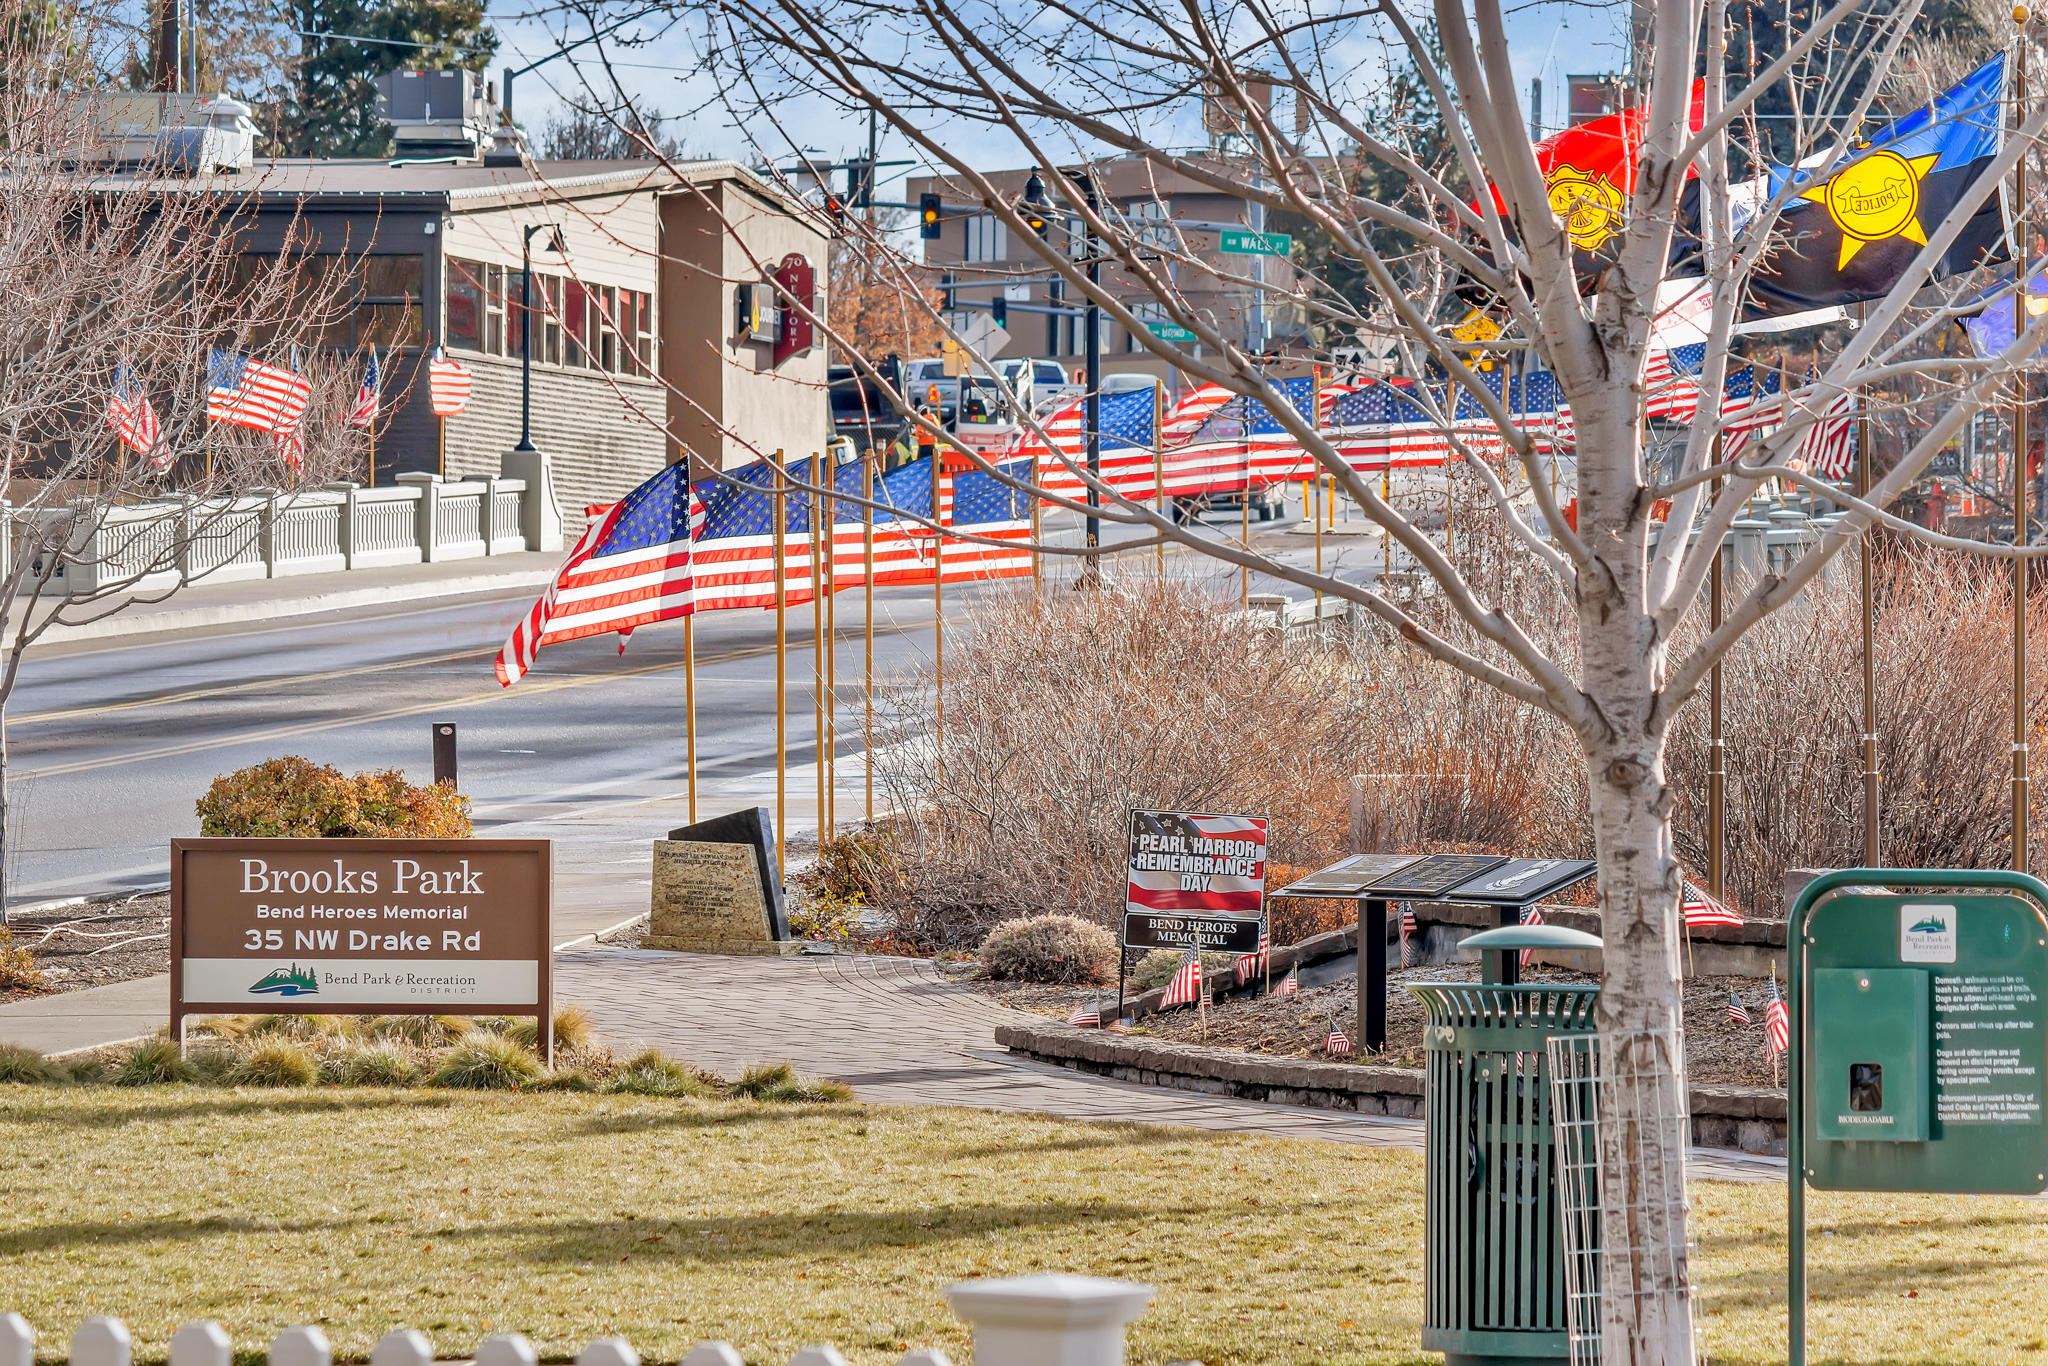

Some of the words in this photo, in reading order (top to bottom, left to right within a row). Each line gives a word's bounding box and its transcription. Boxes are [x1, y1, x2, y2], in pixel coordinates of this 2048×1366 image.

[1241, 237, 1271, 251] WALL
[786, 257, 802, 269] 70
[1140, 833, 1188, 853] PEARL
[1193, 838, 1256, 858] HARBOR
[1137, 853, 1256, 877] REMEMBRANCE
[239, 859, 378, 894] Brooks
[392, 859, 485, 894] Park
[1180, 875, 1211, 893] DAY
[257, 905, 305, 919] Bend
[311, 905, 377, 919] Heroes
[383, 905, 468, 920] Memorial
[1149, 919, 1184, 931] BEND
[1187, 921, 1237, 933] HEROES
[244, 929, 283, 951] 35
[295, 929, 339, 951] NW
[349, 930, 432, 951] Drake
[442, 930, 481, 952] Rd
[1157, 931, 1227, 945] MEMORIAL
[324, 972, 358, 985] Bend
[363, 973, 391, 985] Park
[394, 974, 403, 985] &
[407, 973, 476, 986] Recreation
[1838, 1115, 1894, 1124] BIODEGRADABLE
